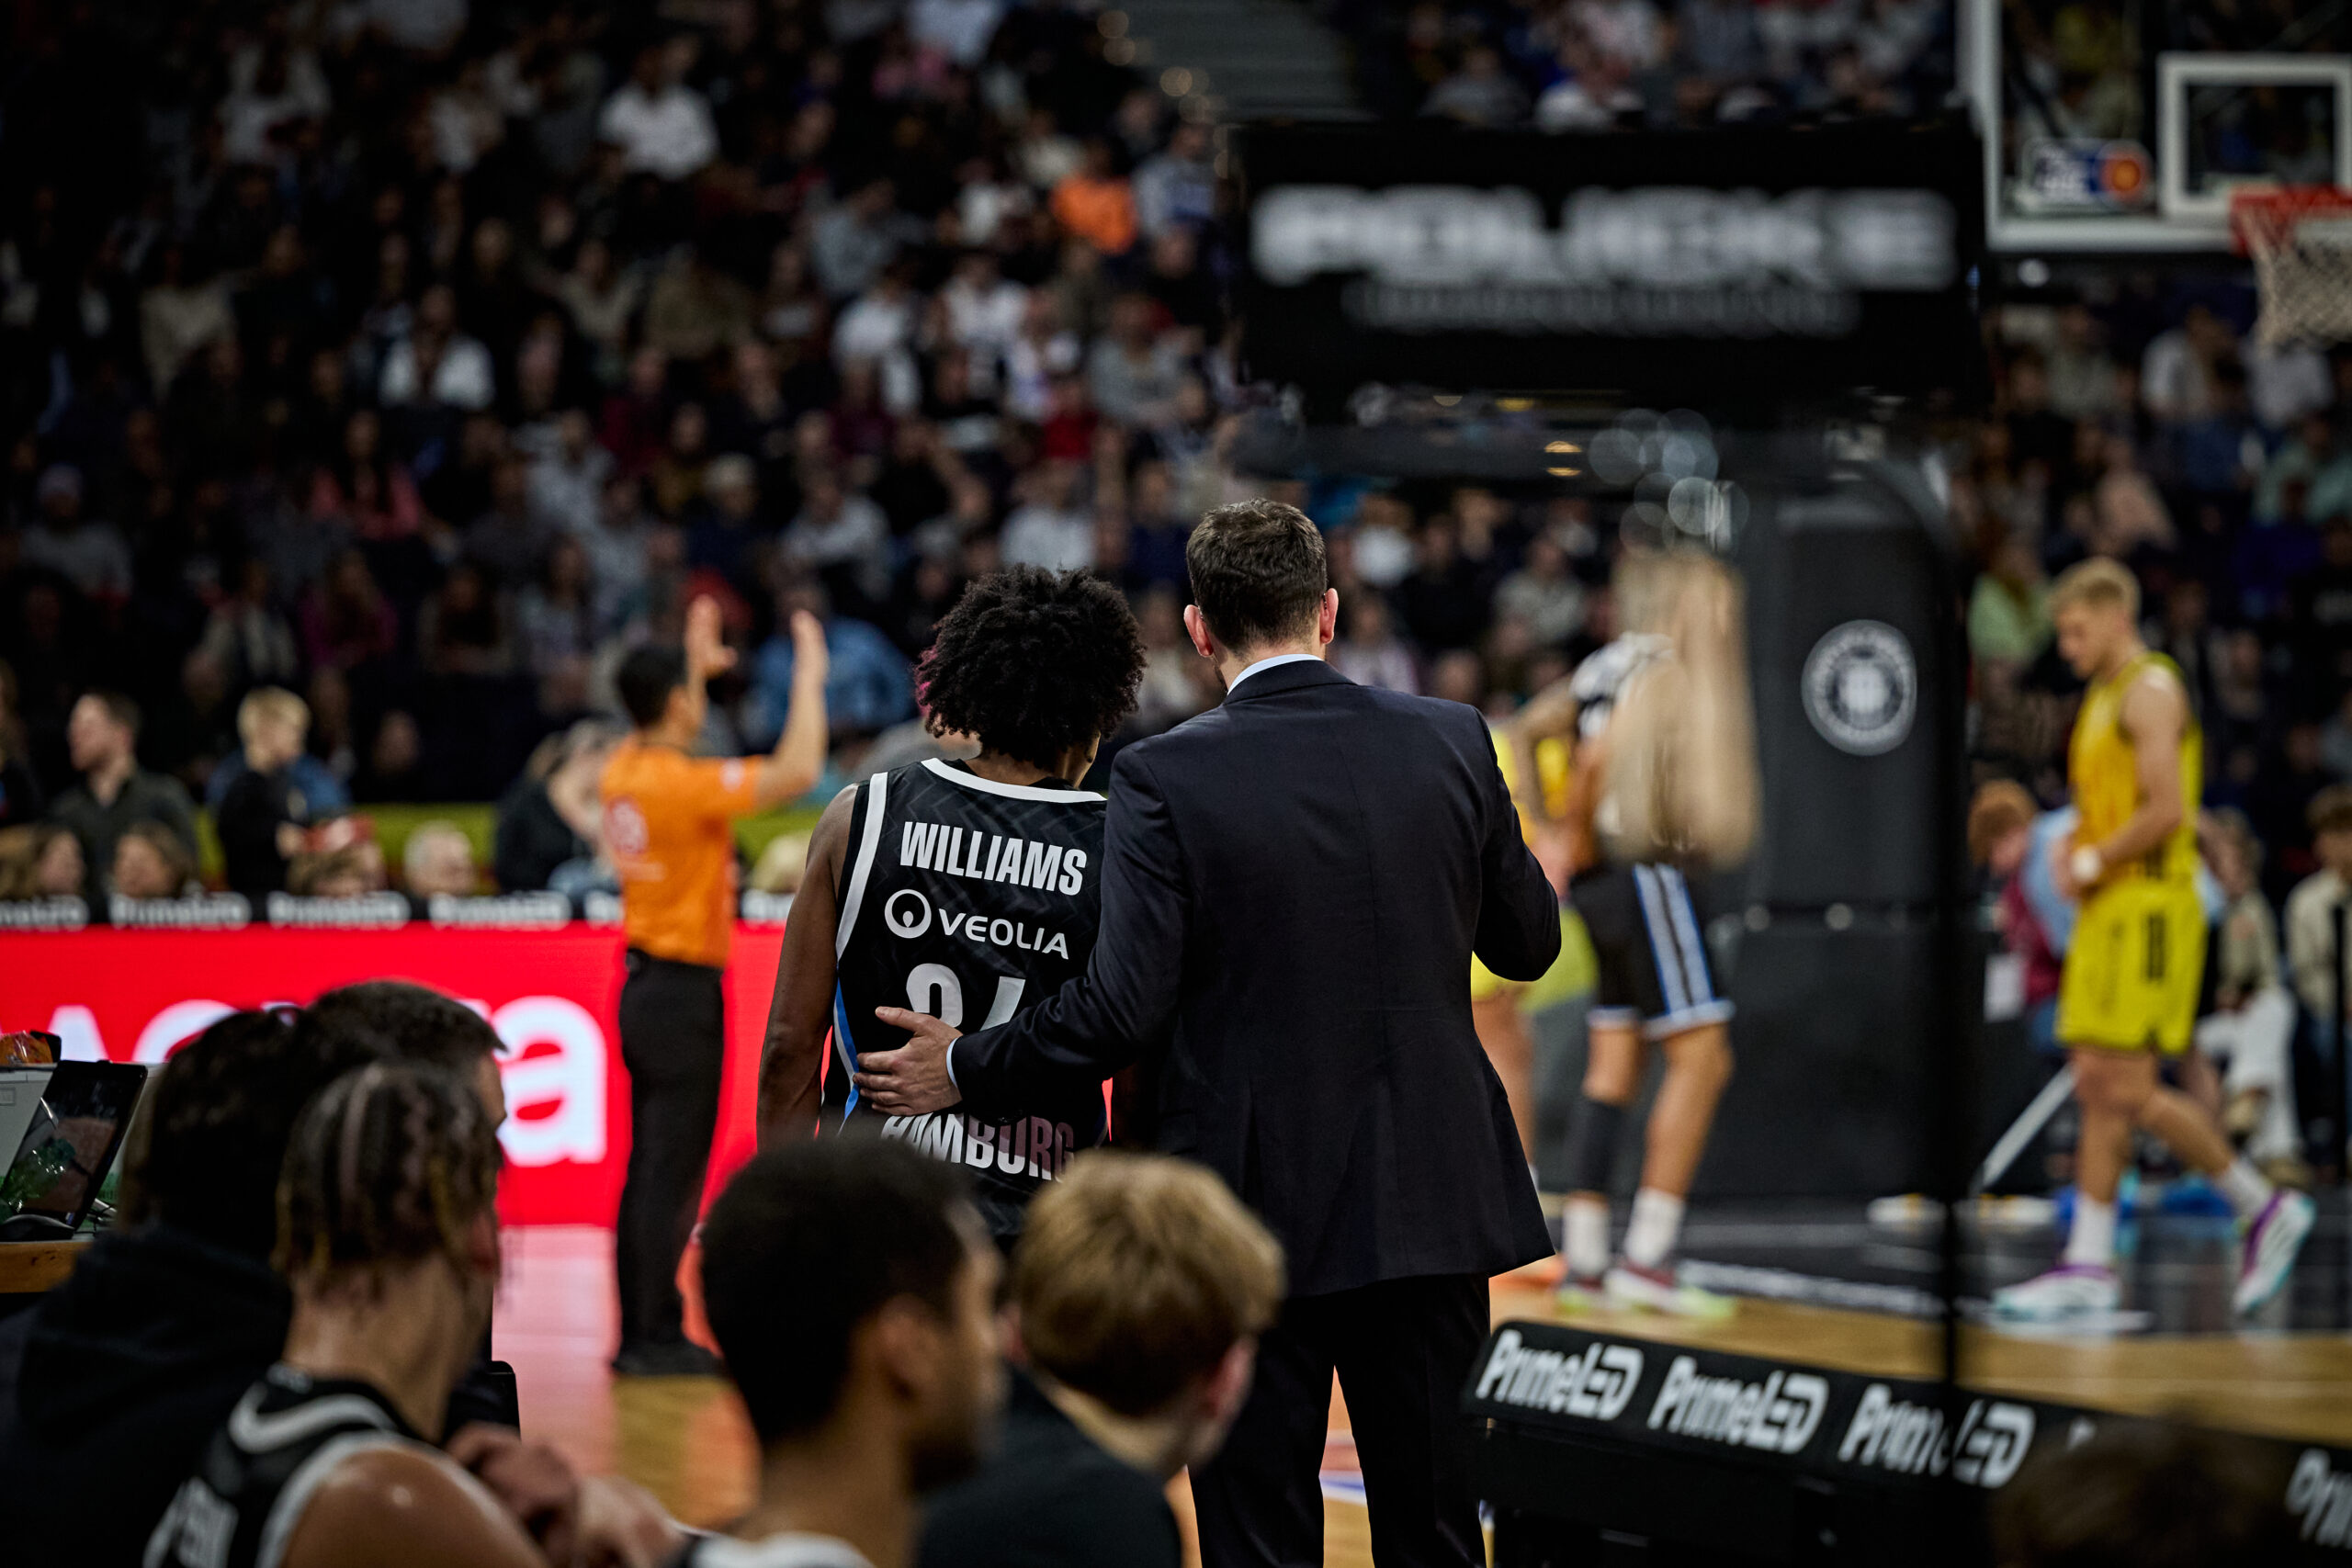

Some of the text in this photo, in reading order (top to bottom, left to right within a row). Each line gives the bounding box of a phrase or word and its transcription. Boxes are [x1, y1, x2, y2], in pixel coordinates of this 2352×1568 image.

[900, 821, 1088, 897] WILLIAMS
[938, 908, 1069, 960] VEOLIA
[1476, 1329, 1645, 1422] PrimeLED
[1647, 1355, 1831, 1455] PrimeLED
